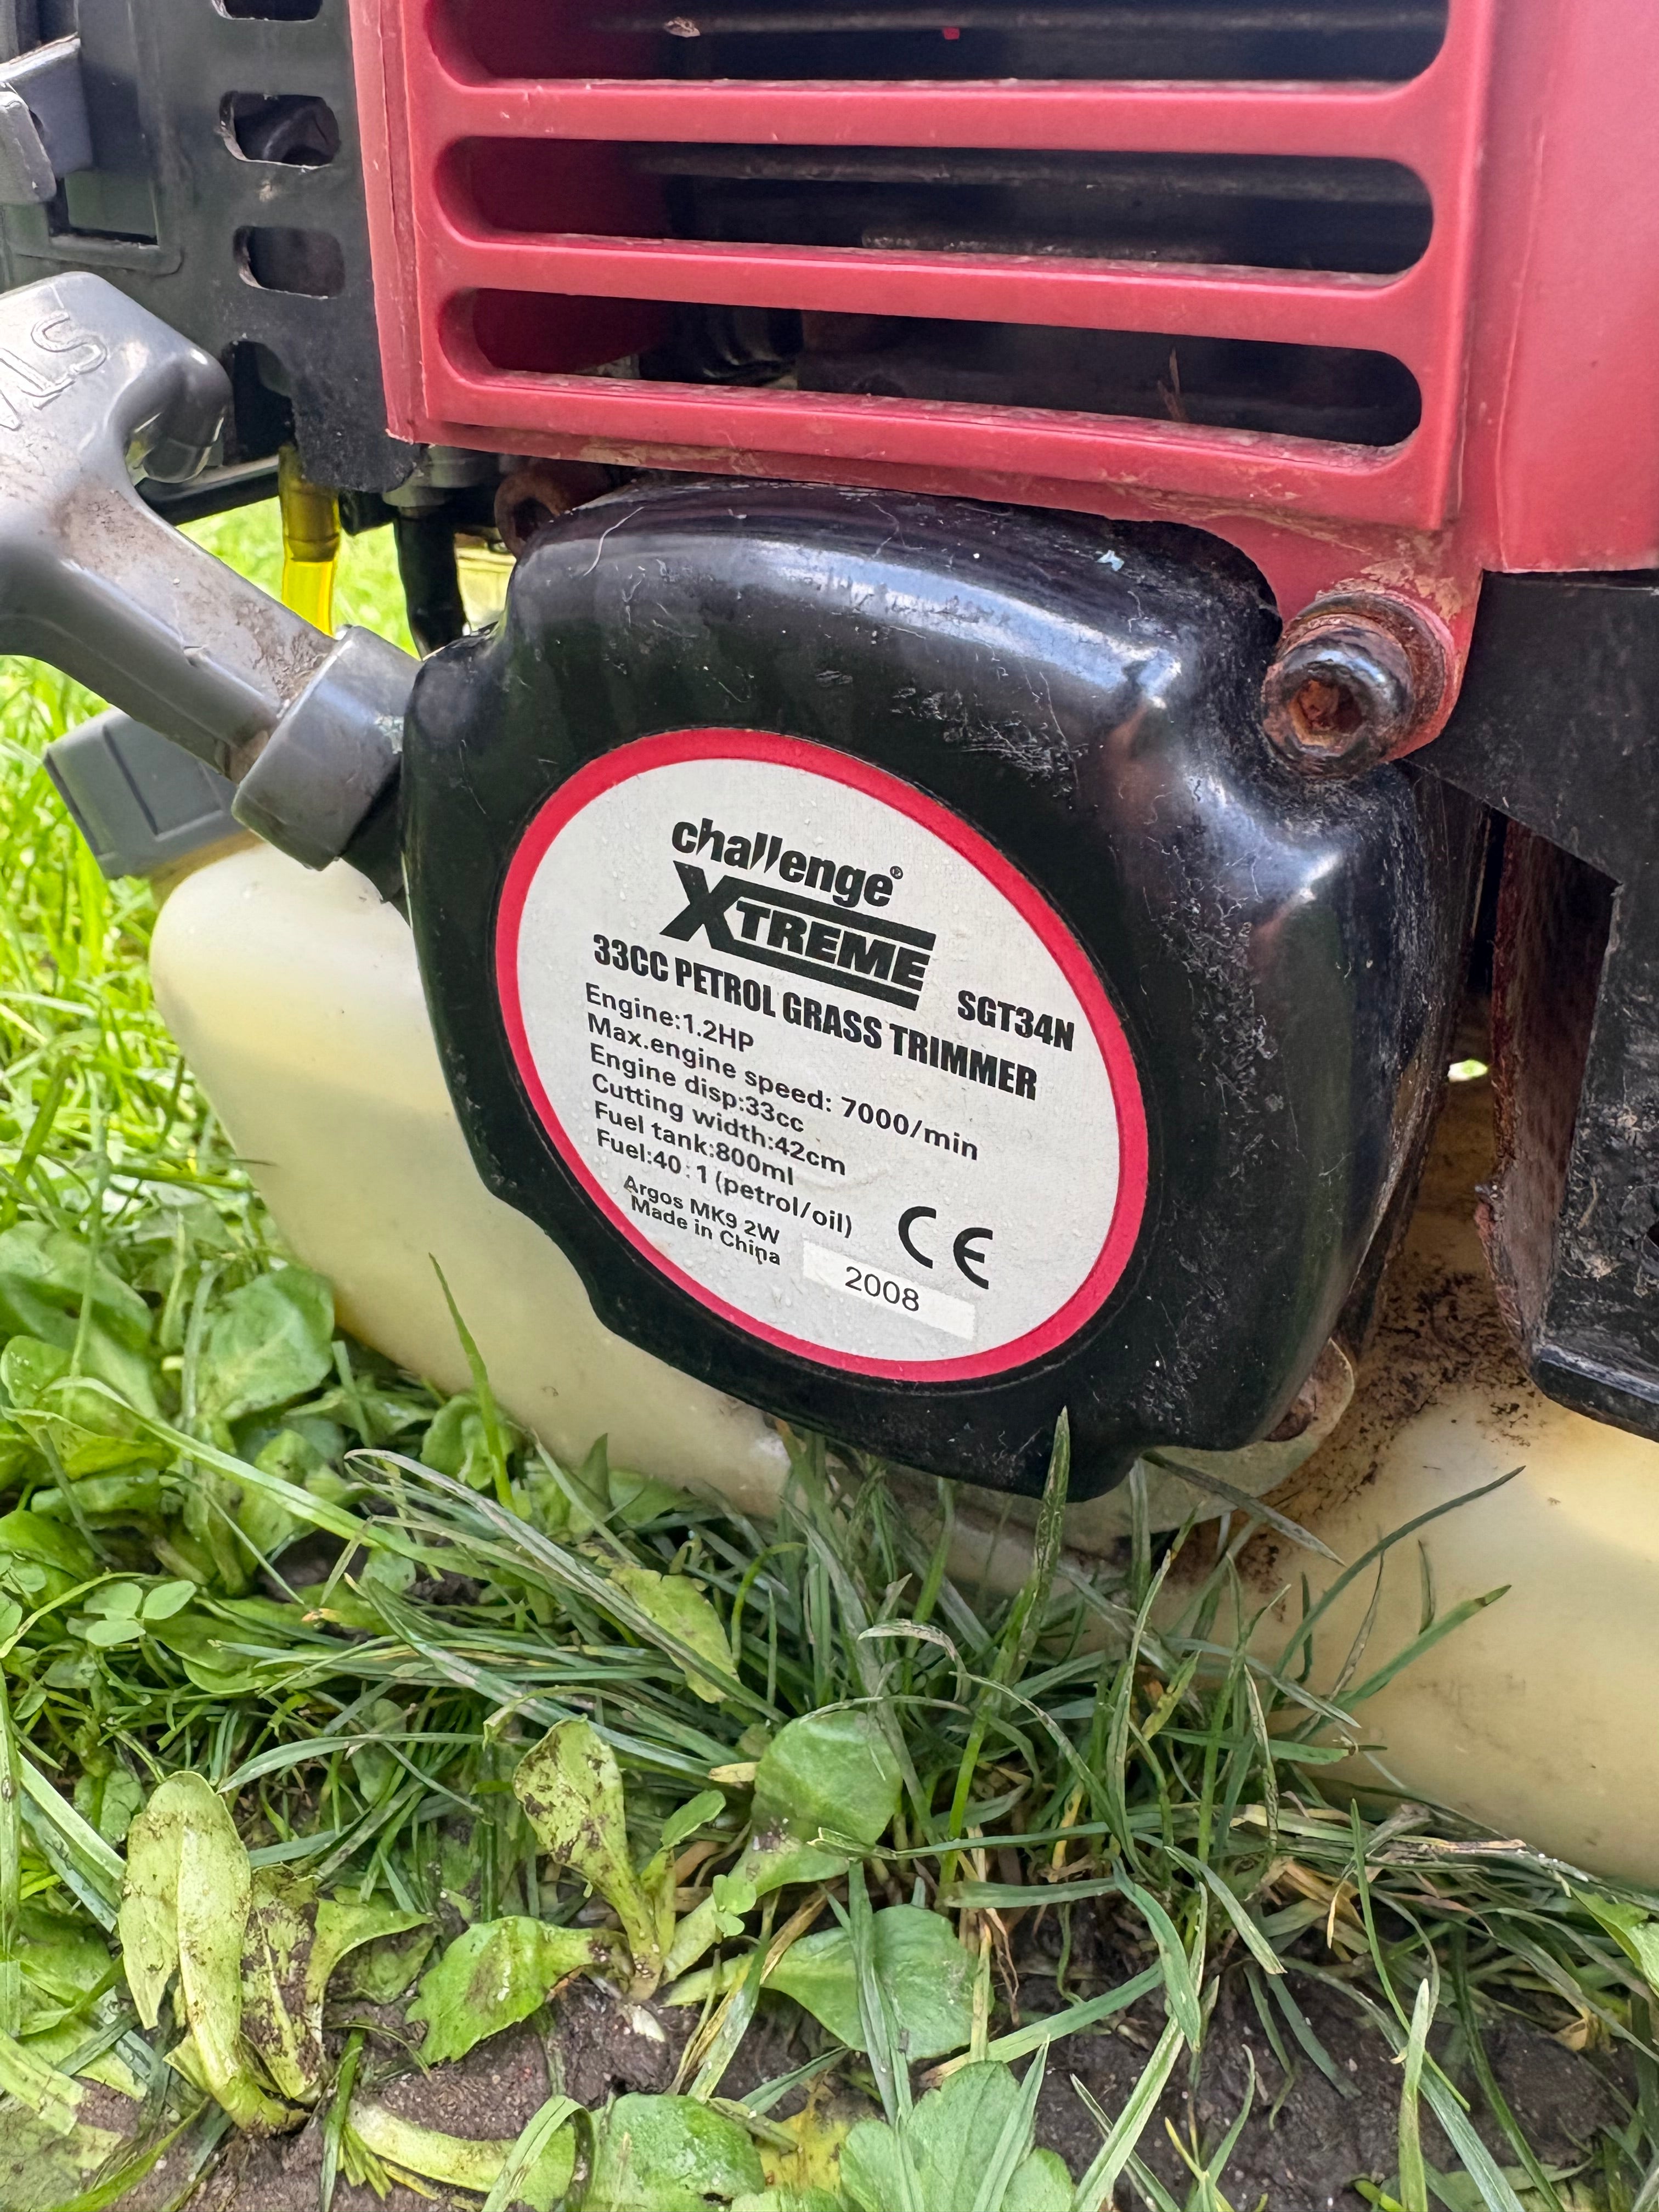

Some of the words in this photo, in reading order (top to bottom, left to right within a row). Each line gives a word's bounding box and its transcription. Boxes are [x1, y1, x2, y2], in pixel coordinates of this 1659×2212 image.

[659, 860, 936, 1011] XTREME
[586, 982, 754, 1052] Engine:1.2HP
[594, 934, 668, 982] 33CC
[675, 957, 776, 1018] PETROL
[783, 991, 882, 1049] GRASS
[889, 1023, 1037, 1101] TRIMMER
[958, 990, 1074, 1052] SGT34N
[590, 1042, 676, 1087] Engine
[685, 1075, 804, 1132] disp:33cc
[592, 1073, 683, 1122] Cutting
[692, 1108, 845, 1176] width:42cm
[744, 1070, 832, 1112] speed:
[842, 1096, 978, 1161] 7000/min
[595, 1101, 644, 1134] Fuel
[651, 1122, 793, 1186] tank:800ml
[623, 1175, 684, 1209] Argos
[690, 1198, 737, 1229] MK9
[744, 1219, 780, 1245] 2W
[631, 1194, 687, 1230] Made
[694, 1218, 713, 1240] in
[720, 1229, 781, 1266] China
[715, 1171, 852, 1239] (petrol/oil)
[845, 1266, 919, 1312] 2008
